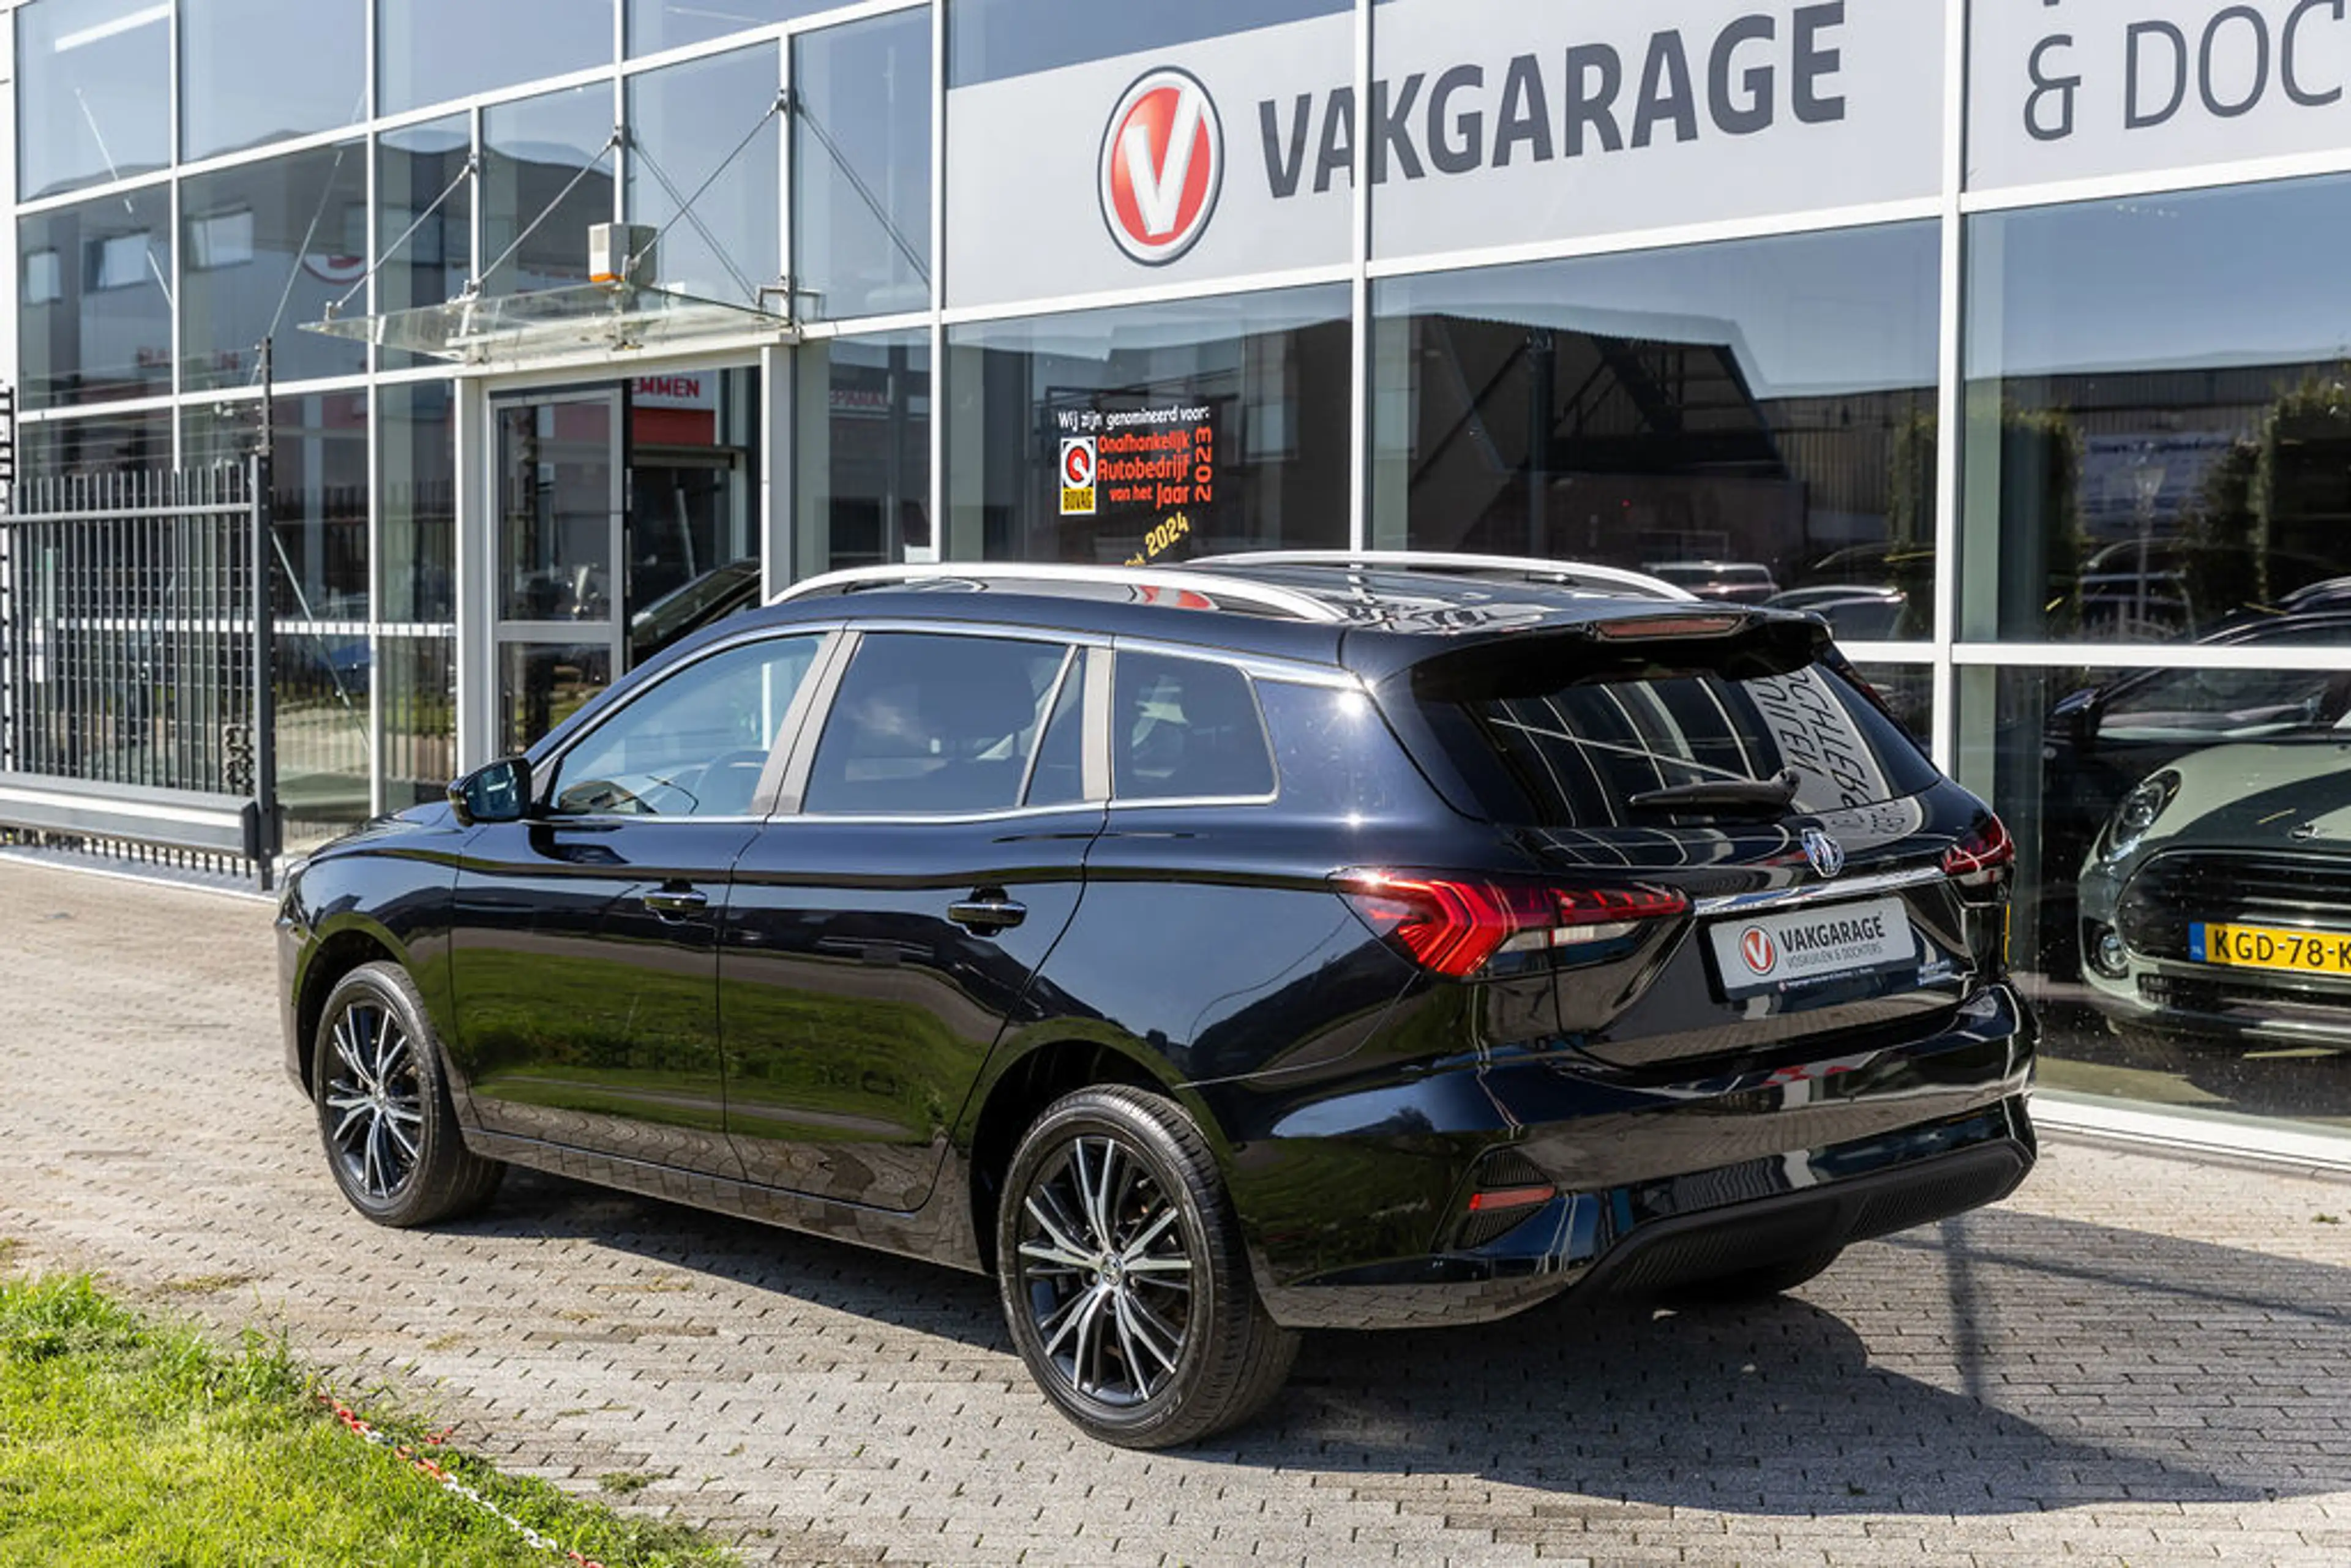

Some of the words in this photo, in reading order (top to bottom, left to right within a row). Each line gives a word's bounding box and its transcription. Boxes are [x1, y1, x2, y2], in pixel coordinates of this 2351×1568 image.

[2024, 34, 2081, 141] &
[2124, 0, 2344, 129] DOC
[1259, 2, 1846, 200] VAKGARAGE
[1058, 411, 1078, 432] Wij
[1081, 411, 1102, 431] zijn
[1106, 405, 1179, 430] genomineerd
[1180, 406, 1210, 421] voor:
[1098, 430, 1190, 453] Onafhankelijk
[1097, 454, 1190, 482] Autobedrijf
[1195, 426, 1212, 502] 2023
[1109, 488, 1131, 502] van
[1133, 485, 1153, 501] het
[1145, 510, 1191, 557] 2024
[1779, 916, 1885, 951] VAKGARAGE
